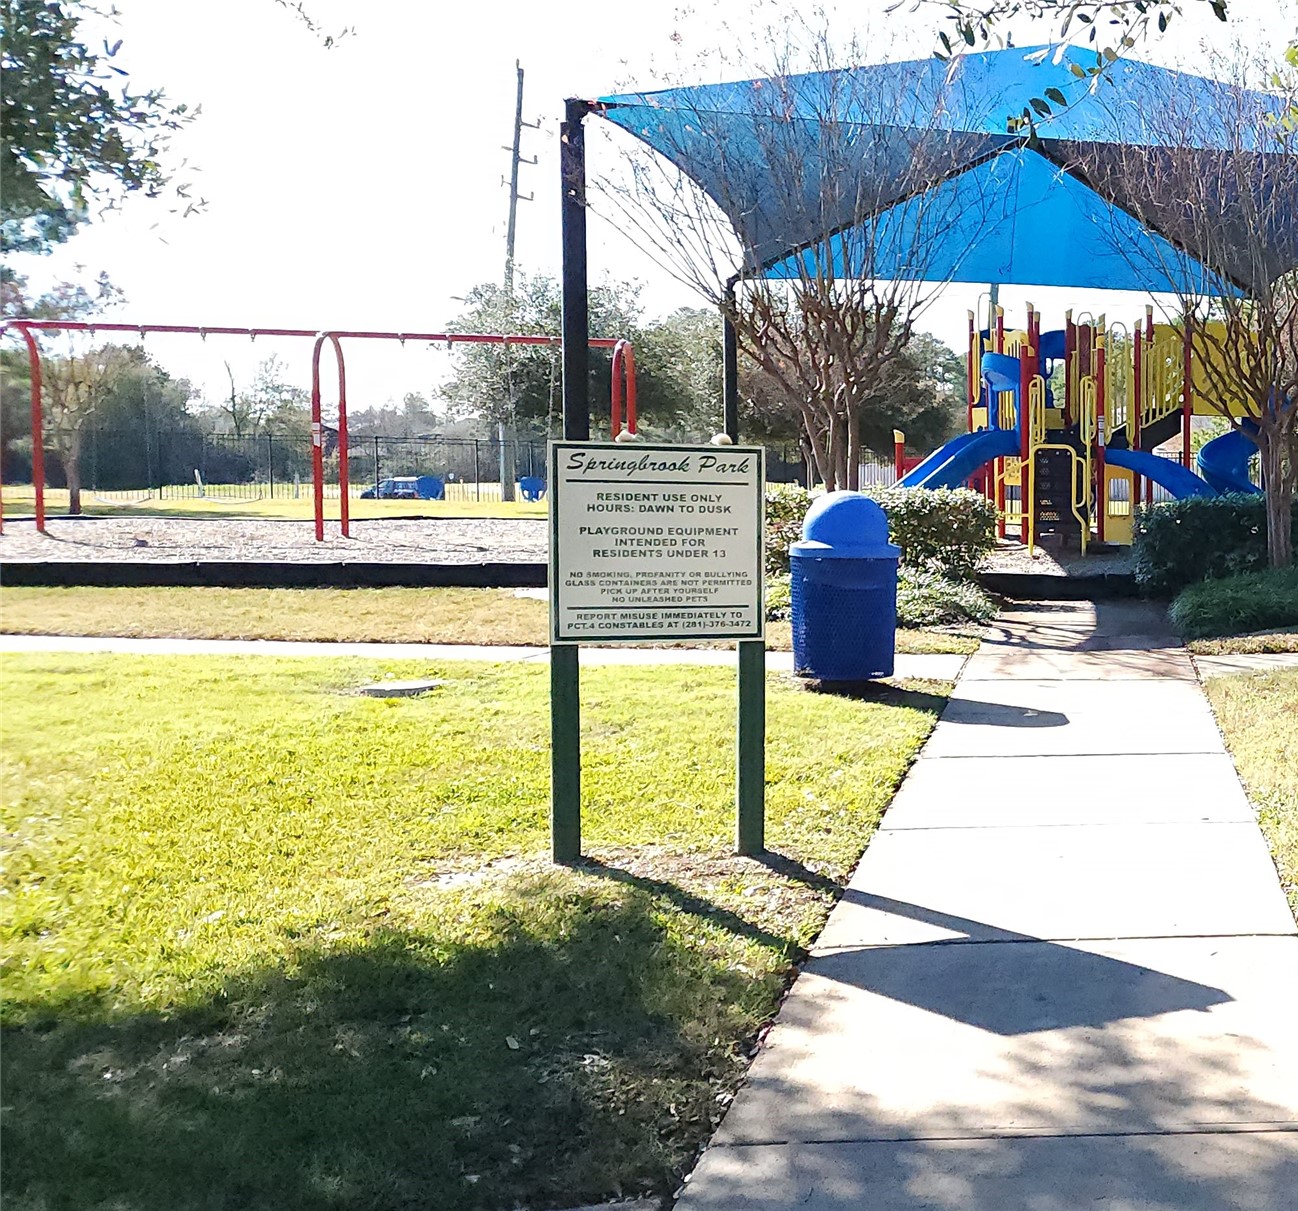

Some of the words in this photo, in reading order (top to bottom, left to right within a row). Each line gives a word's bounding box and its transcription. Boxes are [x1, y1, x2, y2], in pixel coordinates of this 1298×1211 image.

[567, 452, 690, 476] Springbrook
[698, 456, 750, 474] Park
[597, 493, 658, 501] RESIDENT
[663, 494, 687, 502] USE
[691, 494, 722, 502] ONLY
[587, 504, 634, 512] HOURS:
[639, 505, 674, 513] DAWN
[679, 505, 694, 513] TO
[699, 505, 731, 514] DUSK
[579, 527, 663, 535] PLAYGROUND
[668, 528, 738, 536] EQUIPMENT
[615, 539, 677, 547] INTENDED
[682, 539, 705, 547] FOR
[593, 550, 662, 558] RESIDENTS
[667, 550, 708, 558] UNDER
[713, 550, 726, 558] 13
[598, 621, 663, 629] CONSTABLES
[682, 620, 751, 629] (281)-376-3472
